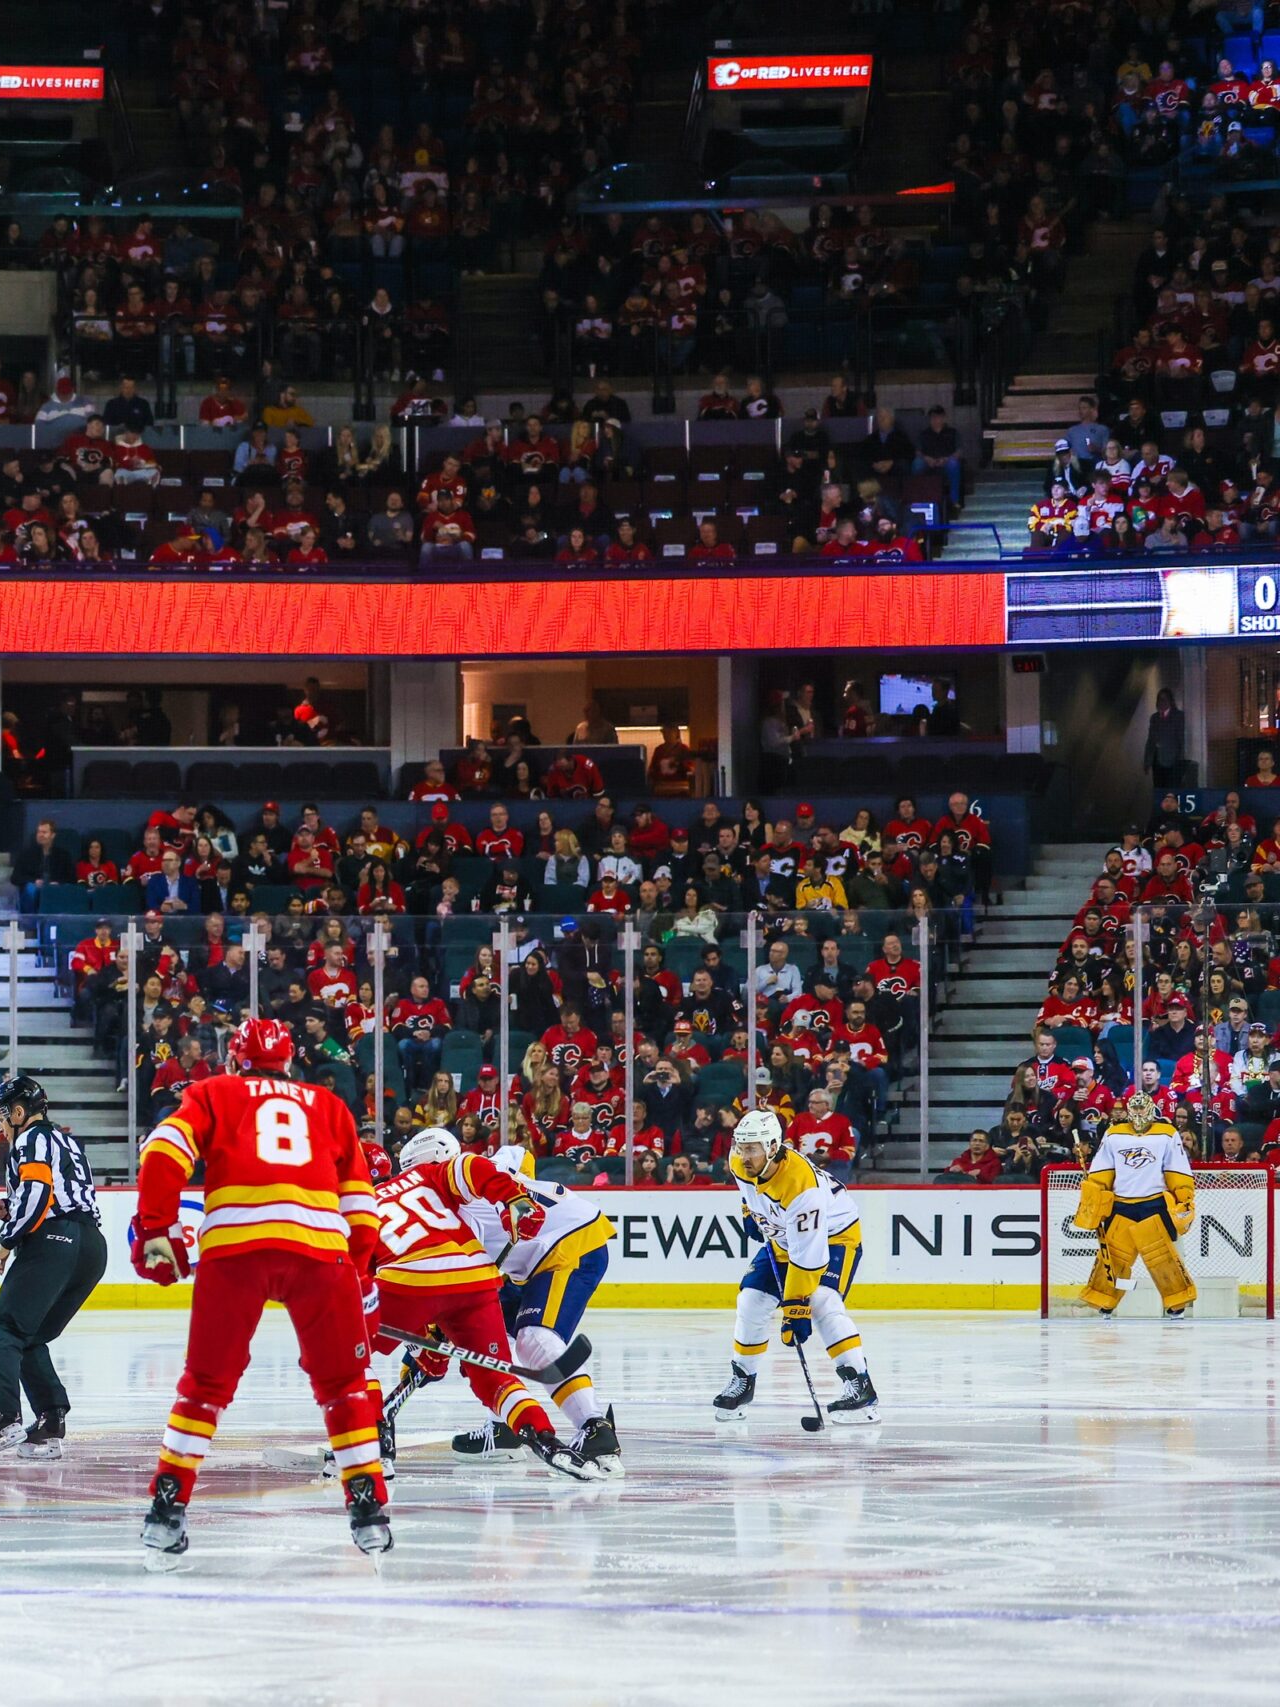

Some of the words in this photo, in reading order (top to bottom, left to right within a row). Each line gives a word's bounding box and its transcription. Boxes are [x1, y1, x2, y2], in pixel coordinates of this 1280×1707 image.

[22, 77, 62, 88] LIVES
[64, 78, 100, 88] HERE
[740, 68, 758, 78] OF
[756, 66, 791, 80] RED
[791, 67, 831, 77] LIVES
[833, 65, 869, 76] HERE
[1254, 575, 1277, 610] 0
[245, 1080, 316, 1106] TANEV
[255, 1097, 313, 1167] 8
[376, 1170, 425, 1202] EMAN
[377, 1185, 462, 1256] 20
[796, 1208, 821, 1233] 27
[891, 1214, 1253, 1258] NISSN
[46, 1234, 73, 1244] CCM
[608, 1215, 750, 1259] EWAY
